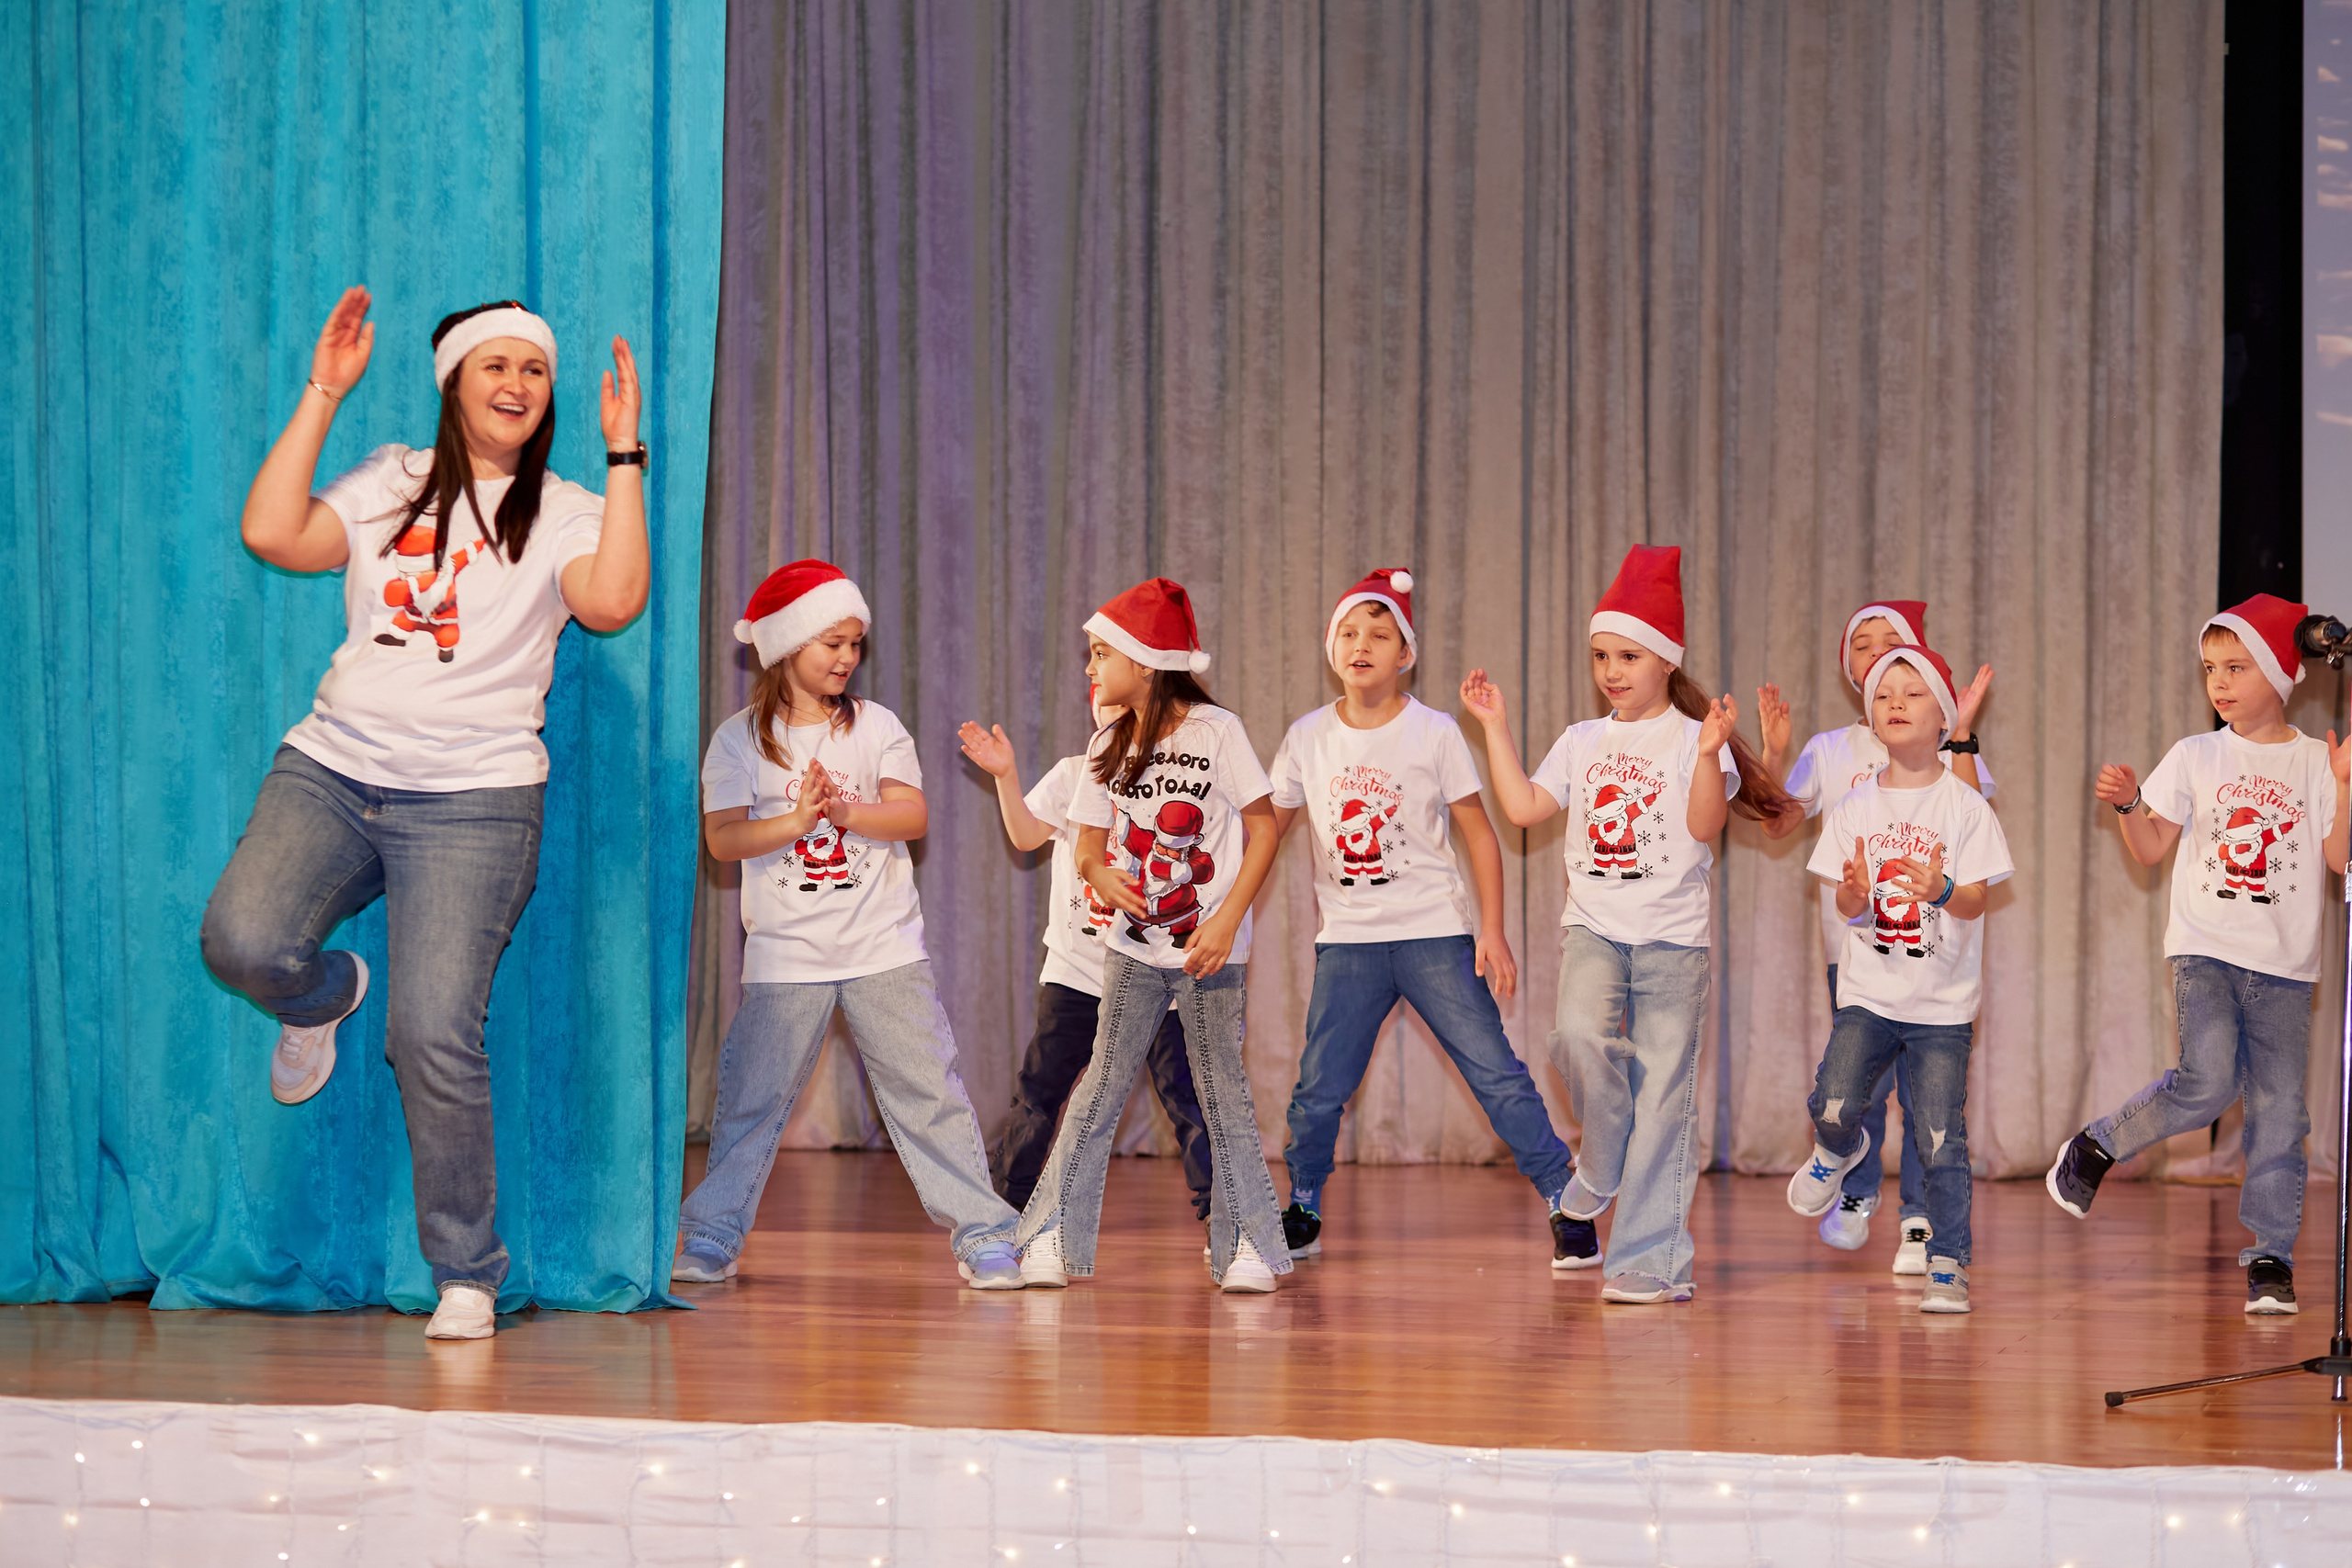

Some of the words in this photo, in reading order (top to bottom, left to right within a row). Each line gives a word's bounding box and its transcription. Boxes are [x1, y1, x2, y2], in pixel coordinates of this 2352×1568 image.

[1352, 765, 1392, 783] Merry
[1615, 752, 1653, 770] Merry
[1155, 774, 1213, 800] Года!
[1329, 775, 1405, 807] Christmas
[1587, 762, 1668, 795] Christmas
[2248, 773, 2292, 796] Merry
[2217, 783, 2306, 824] Christmas
[1896, 821, 1939, 842] Merry
[1868, 833, 1951, 869] Christms
